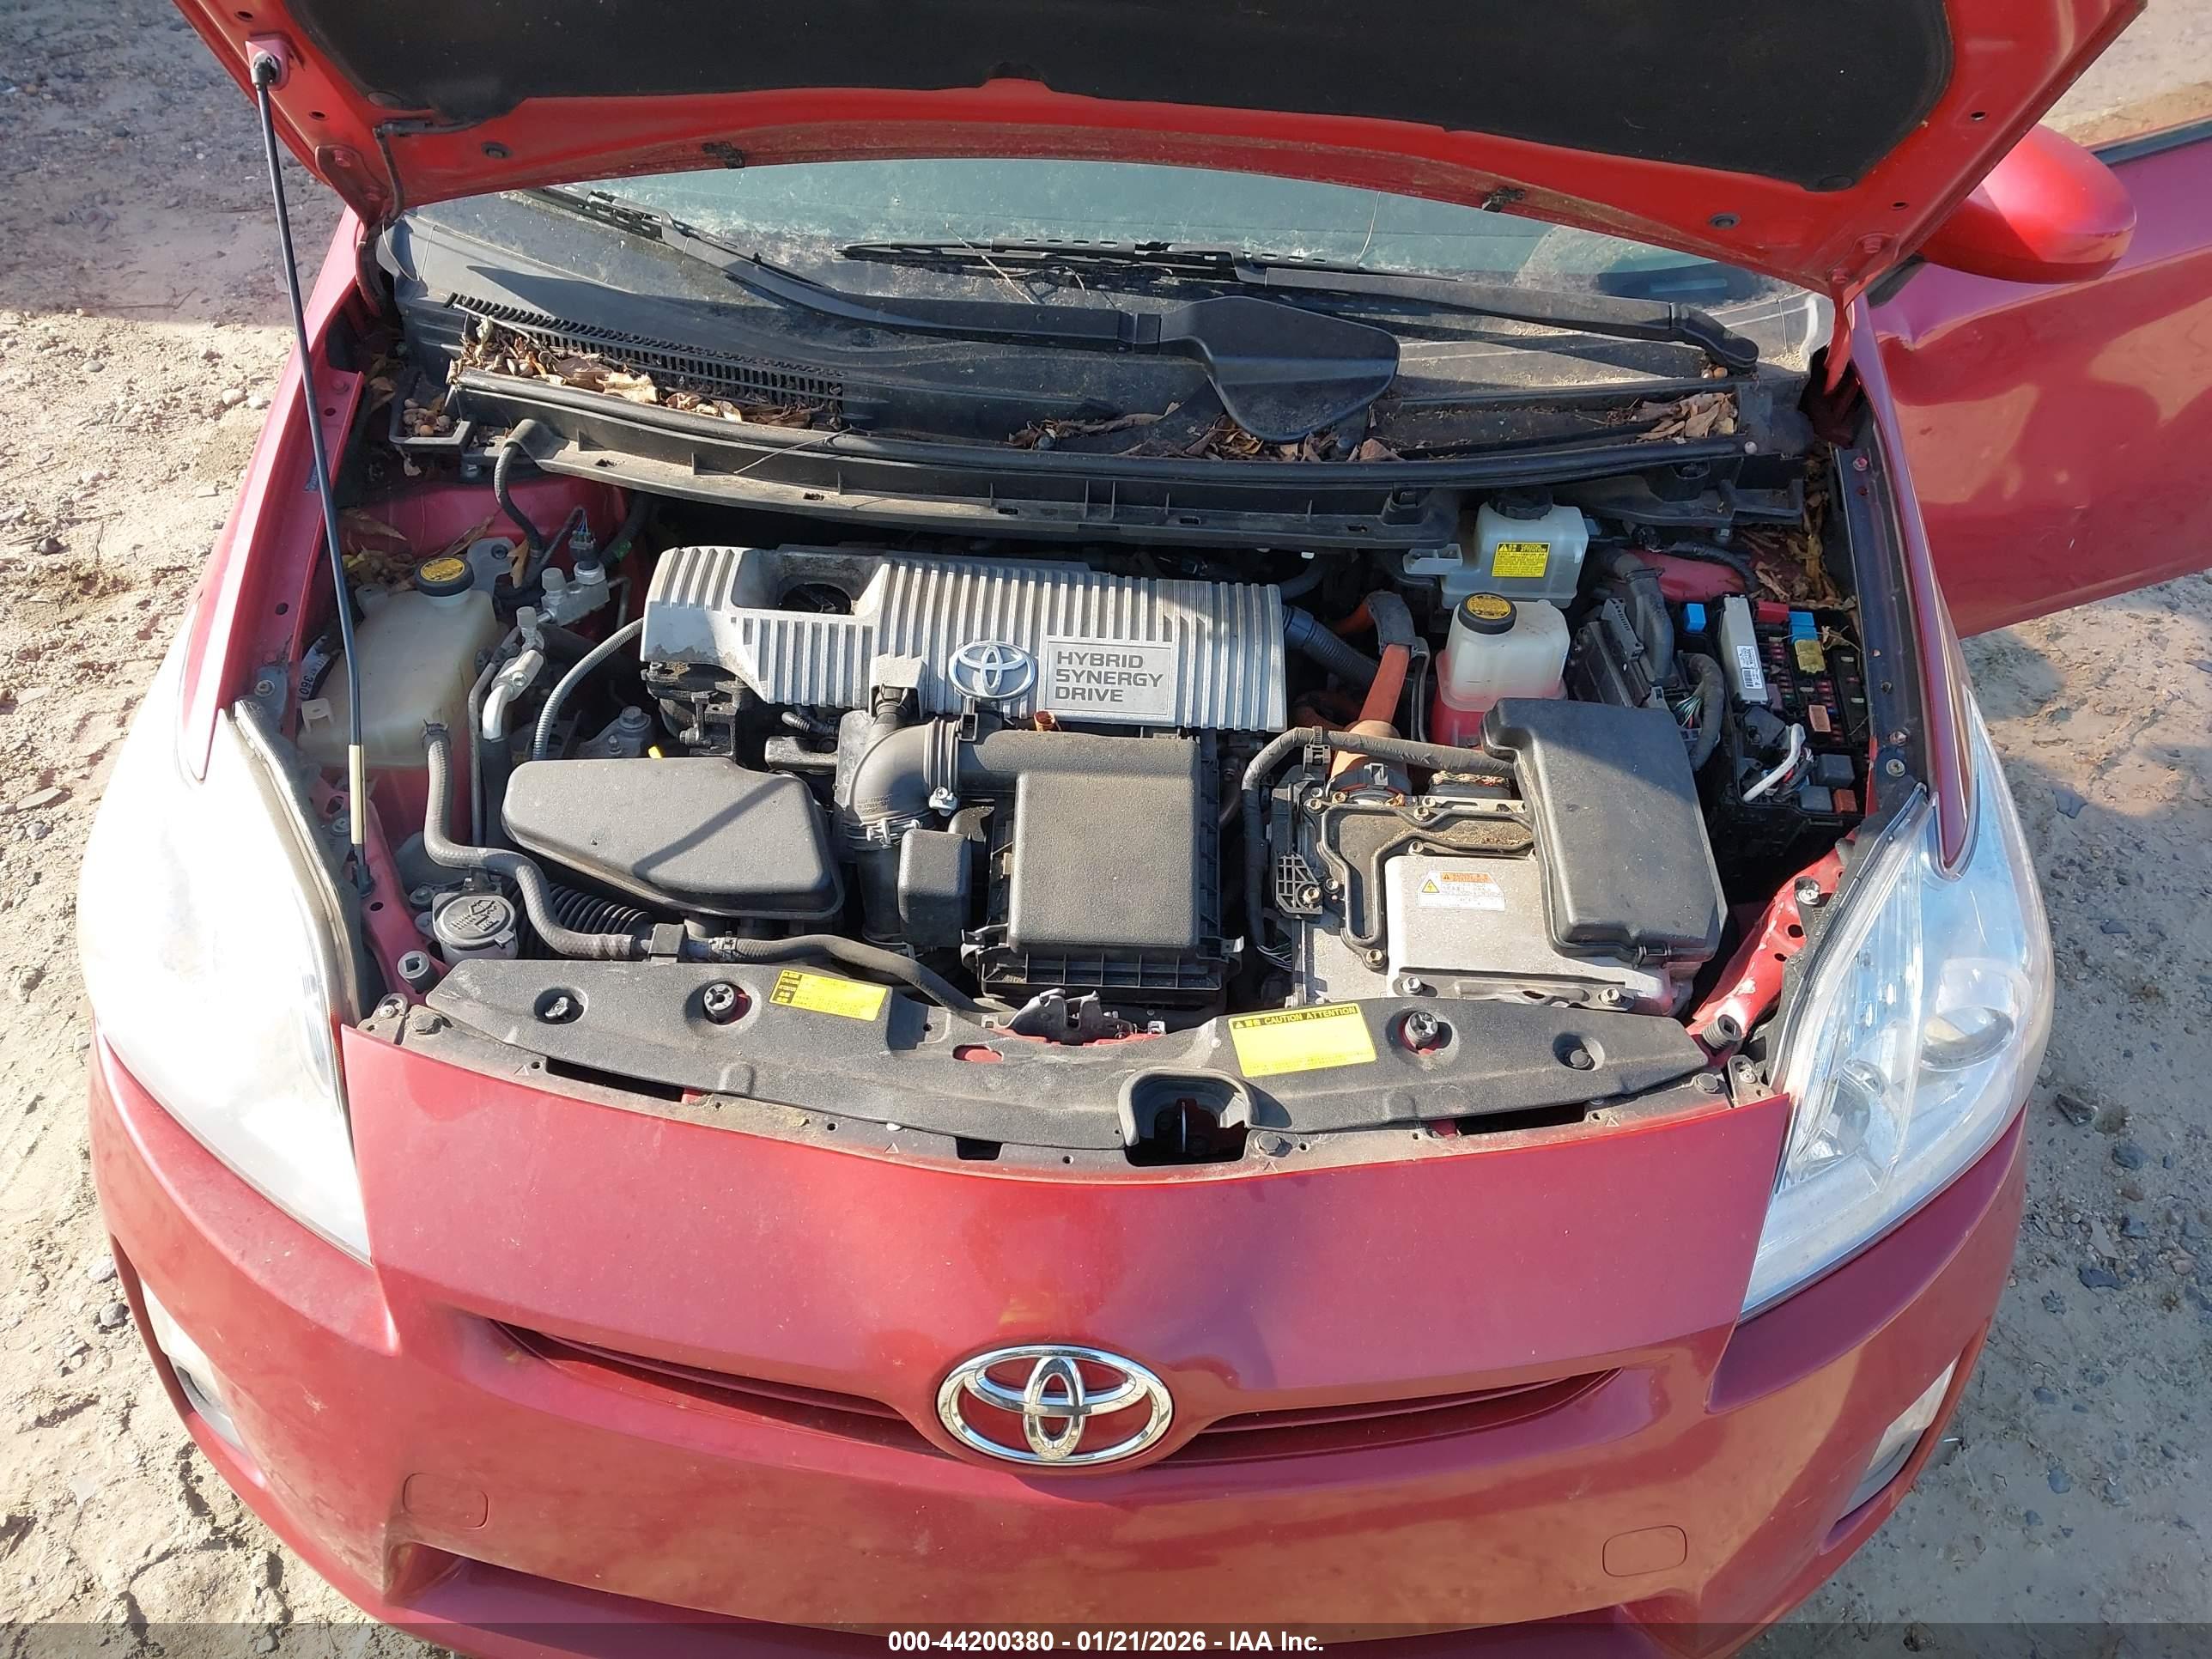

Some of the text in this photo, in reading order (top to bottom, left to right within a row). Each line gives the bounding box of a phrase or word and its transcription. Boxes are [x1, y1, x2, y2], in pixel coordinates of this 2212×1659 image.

[1057, 651, 1144, 669] HYBRID
[1055, 668, 1164, 687] SYNERGY
[1054, 686, 1124, 702] DRIVE
[1264, 1013, 1304, 1025] CAUTION
[1306, 1006, 1357, 1019] ATTENTION
